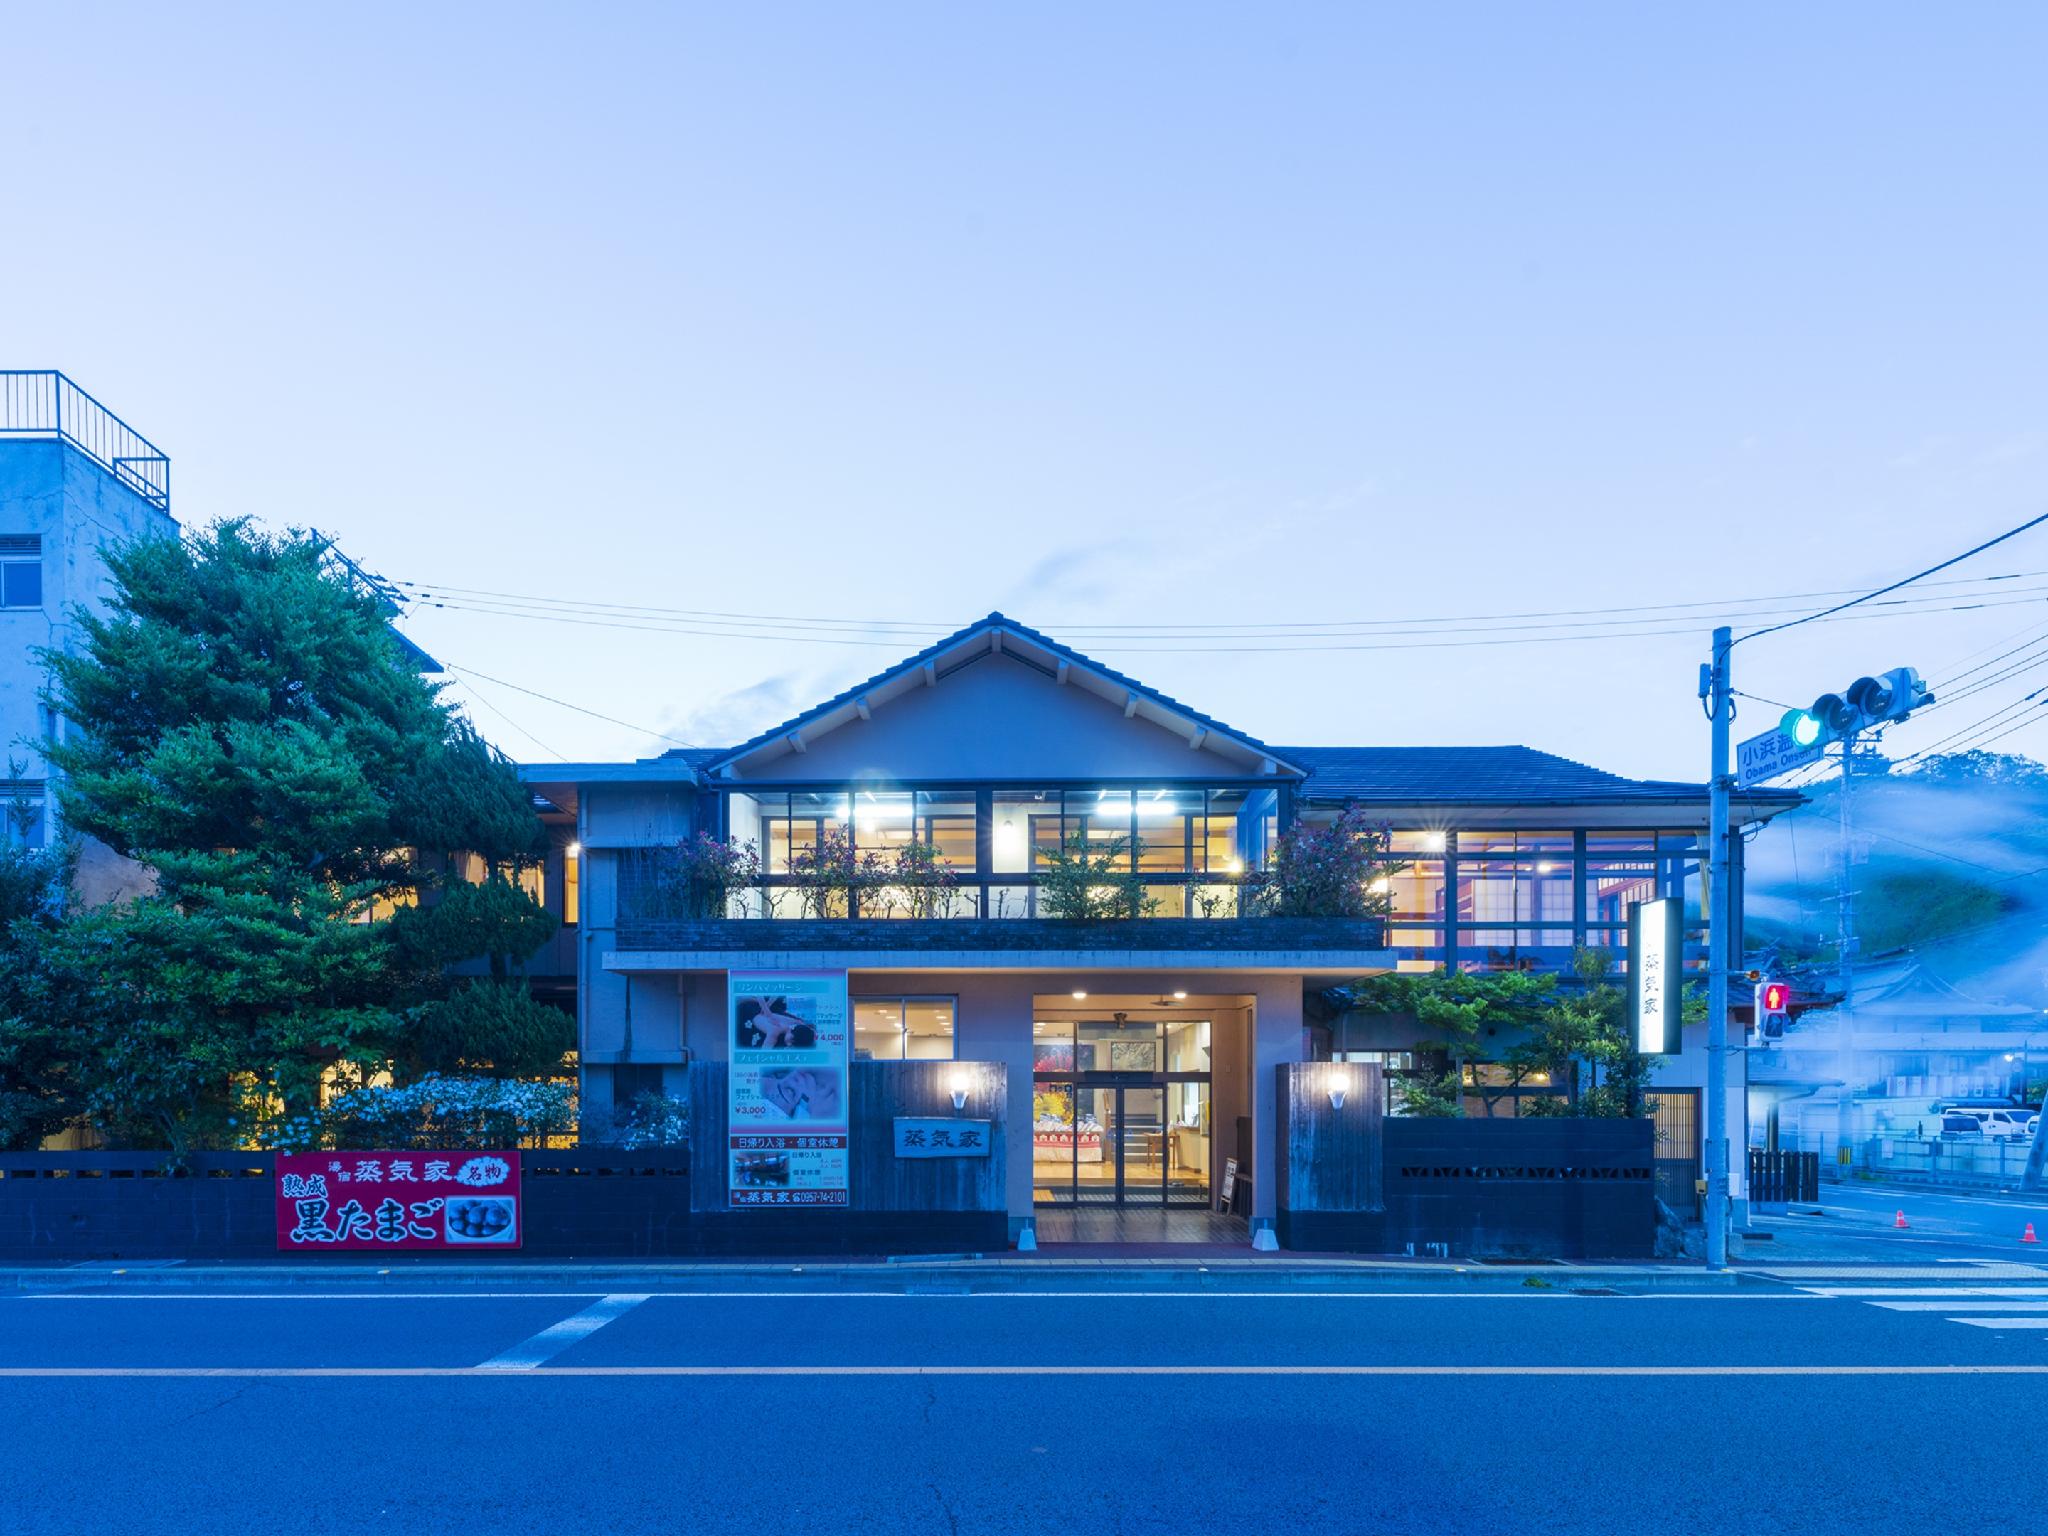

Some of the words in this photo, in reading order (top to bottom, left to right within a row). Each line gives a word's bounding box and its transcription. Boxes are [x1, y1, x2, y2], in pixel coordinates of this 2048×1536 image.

[1743, 733, 1794, 767] 小浜温
[1746, 761, 1778, 780] Obama
[735, 1106, 766, 1114] ¥3,000
[354, 1159, 453, 1183] 蒸気家
[466, 1163, 502, 1181] 名物
[282, 1174, 328, 1198] 熟成
[290, 1197, 445, 1243] 黒たまご
